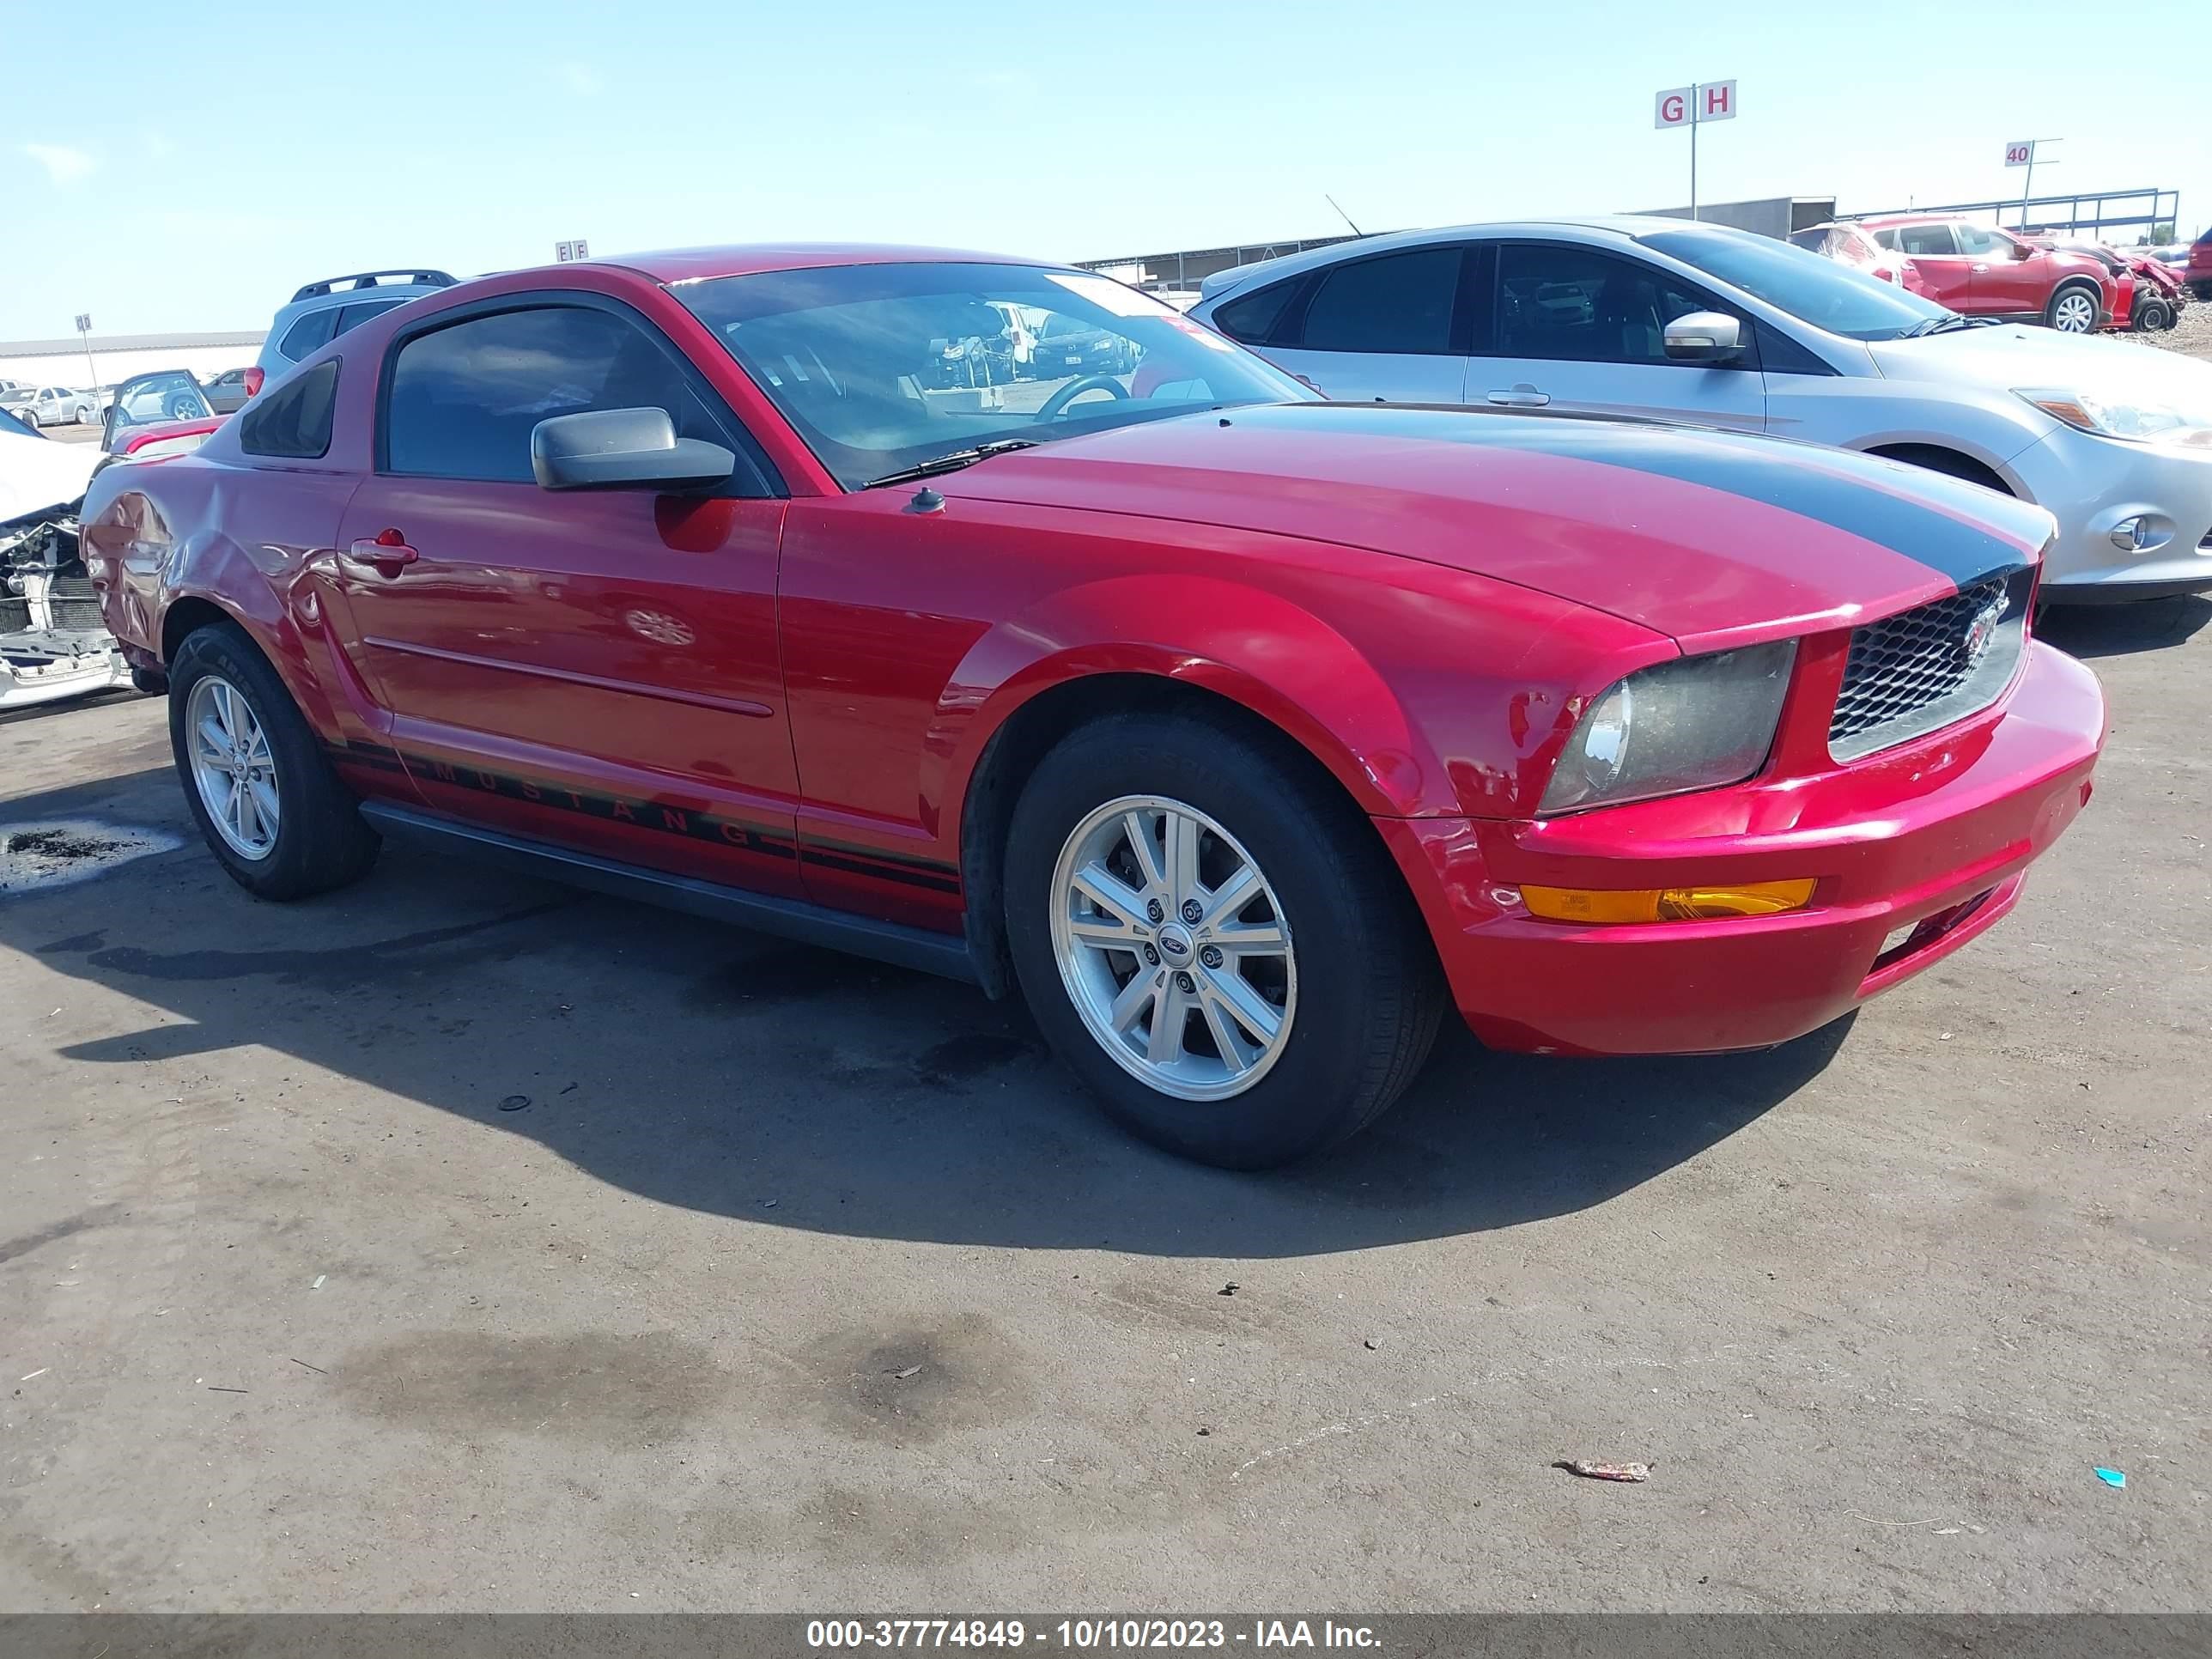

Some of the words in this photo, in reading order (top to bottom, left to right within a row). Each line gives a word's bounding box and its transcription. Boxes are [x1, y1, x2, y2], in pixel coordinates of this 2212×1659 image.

[1662, 95, 1683, 122] G
[1708, 87, 1728, 114] H
[2006, 147, 2028, 162] 40
[559, 246, 567, 262] E
[577, 244, 585, 259] F
[433, 761, 750, 847] MUSTANG
